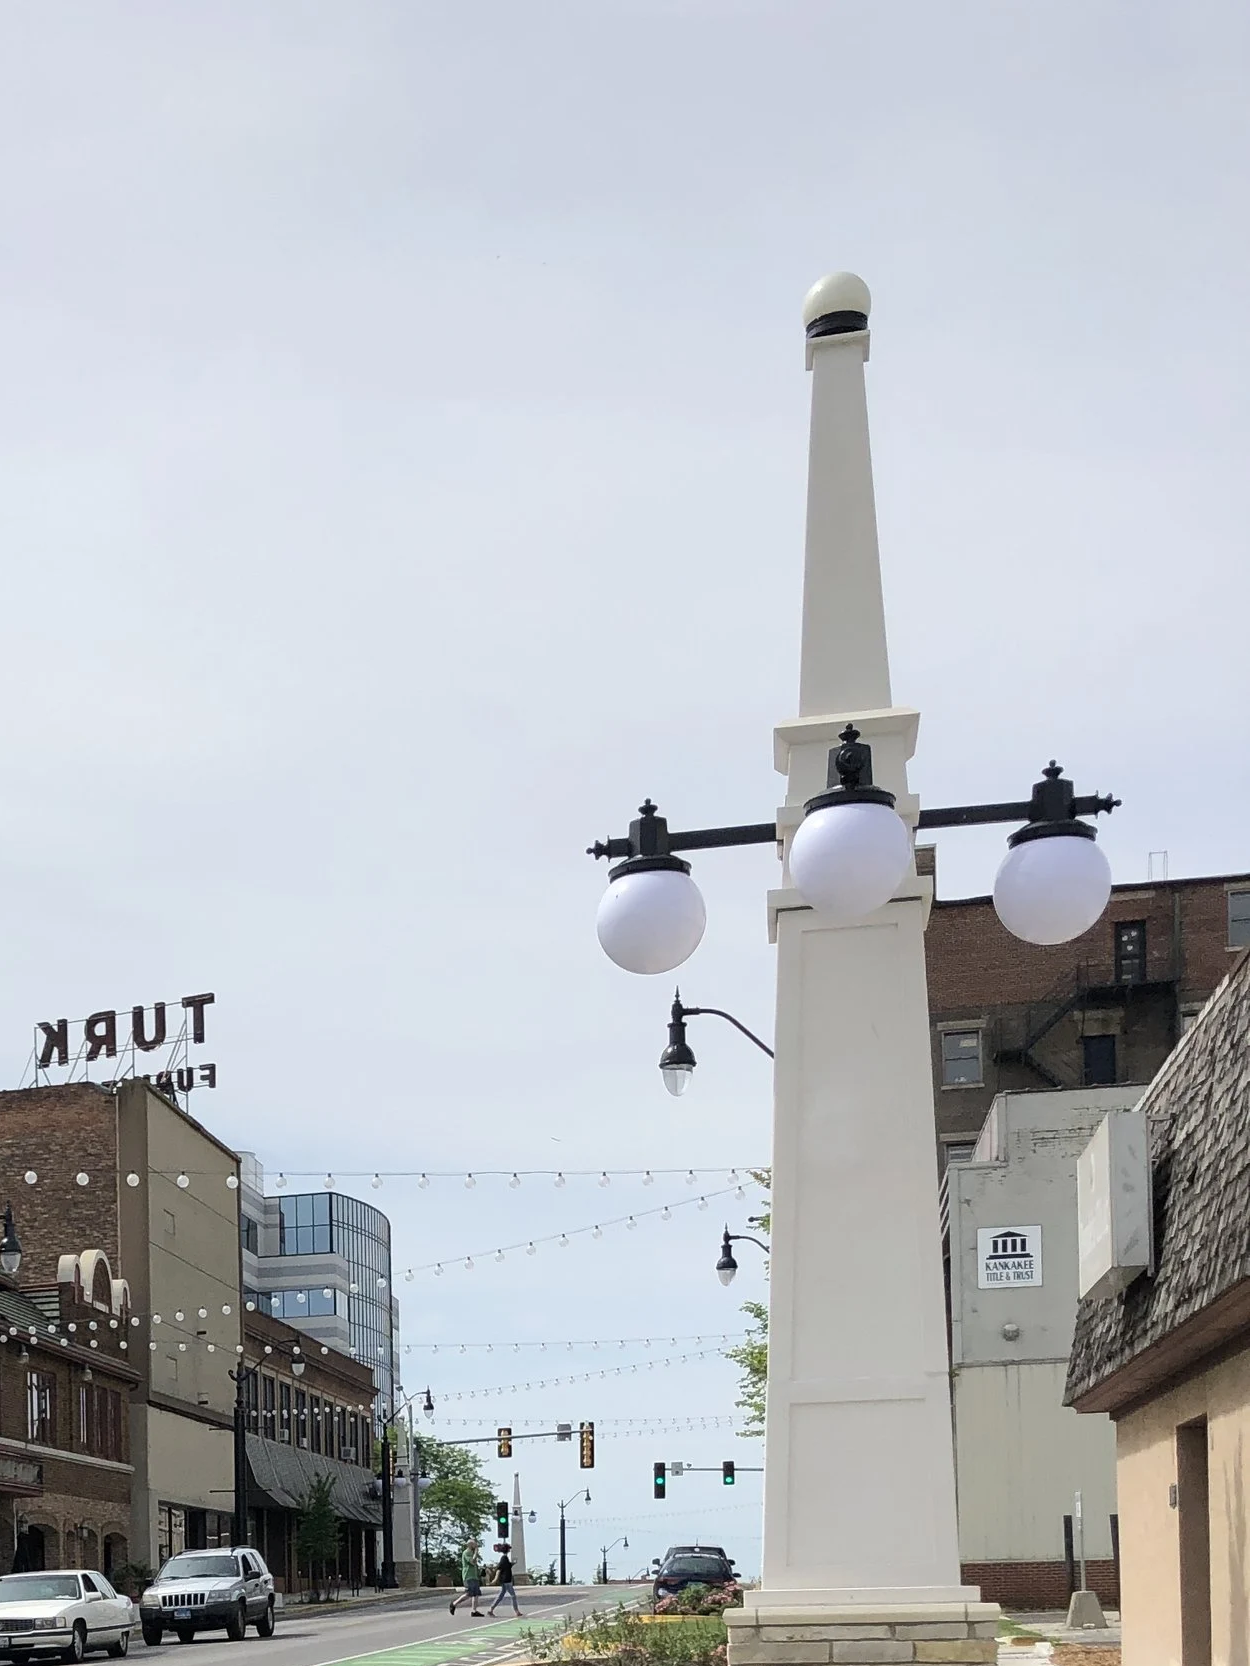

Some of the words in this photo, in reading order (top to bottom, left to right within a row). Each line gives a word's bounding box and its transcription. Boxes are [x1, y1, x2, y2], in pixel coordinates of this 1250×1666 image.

[985, 1260, 1034, 1271] KANKAKEE
[986, 1272, 1004, 1281] TITLE
[1005, 1271, 1011, 1280] &
[1013, 1270, 1034, 1280] TRUST
